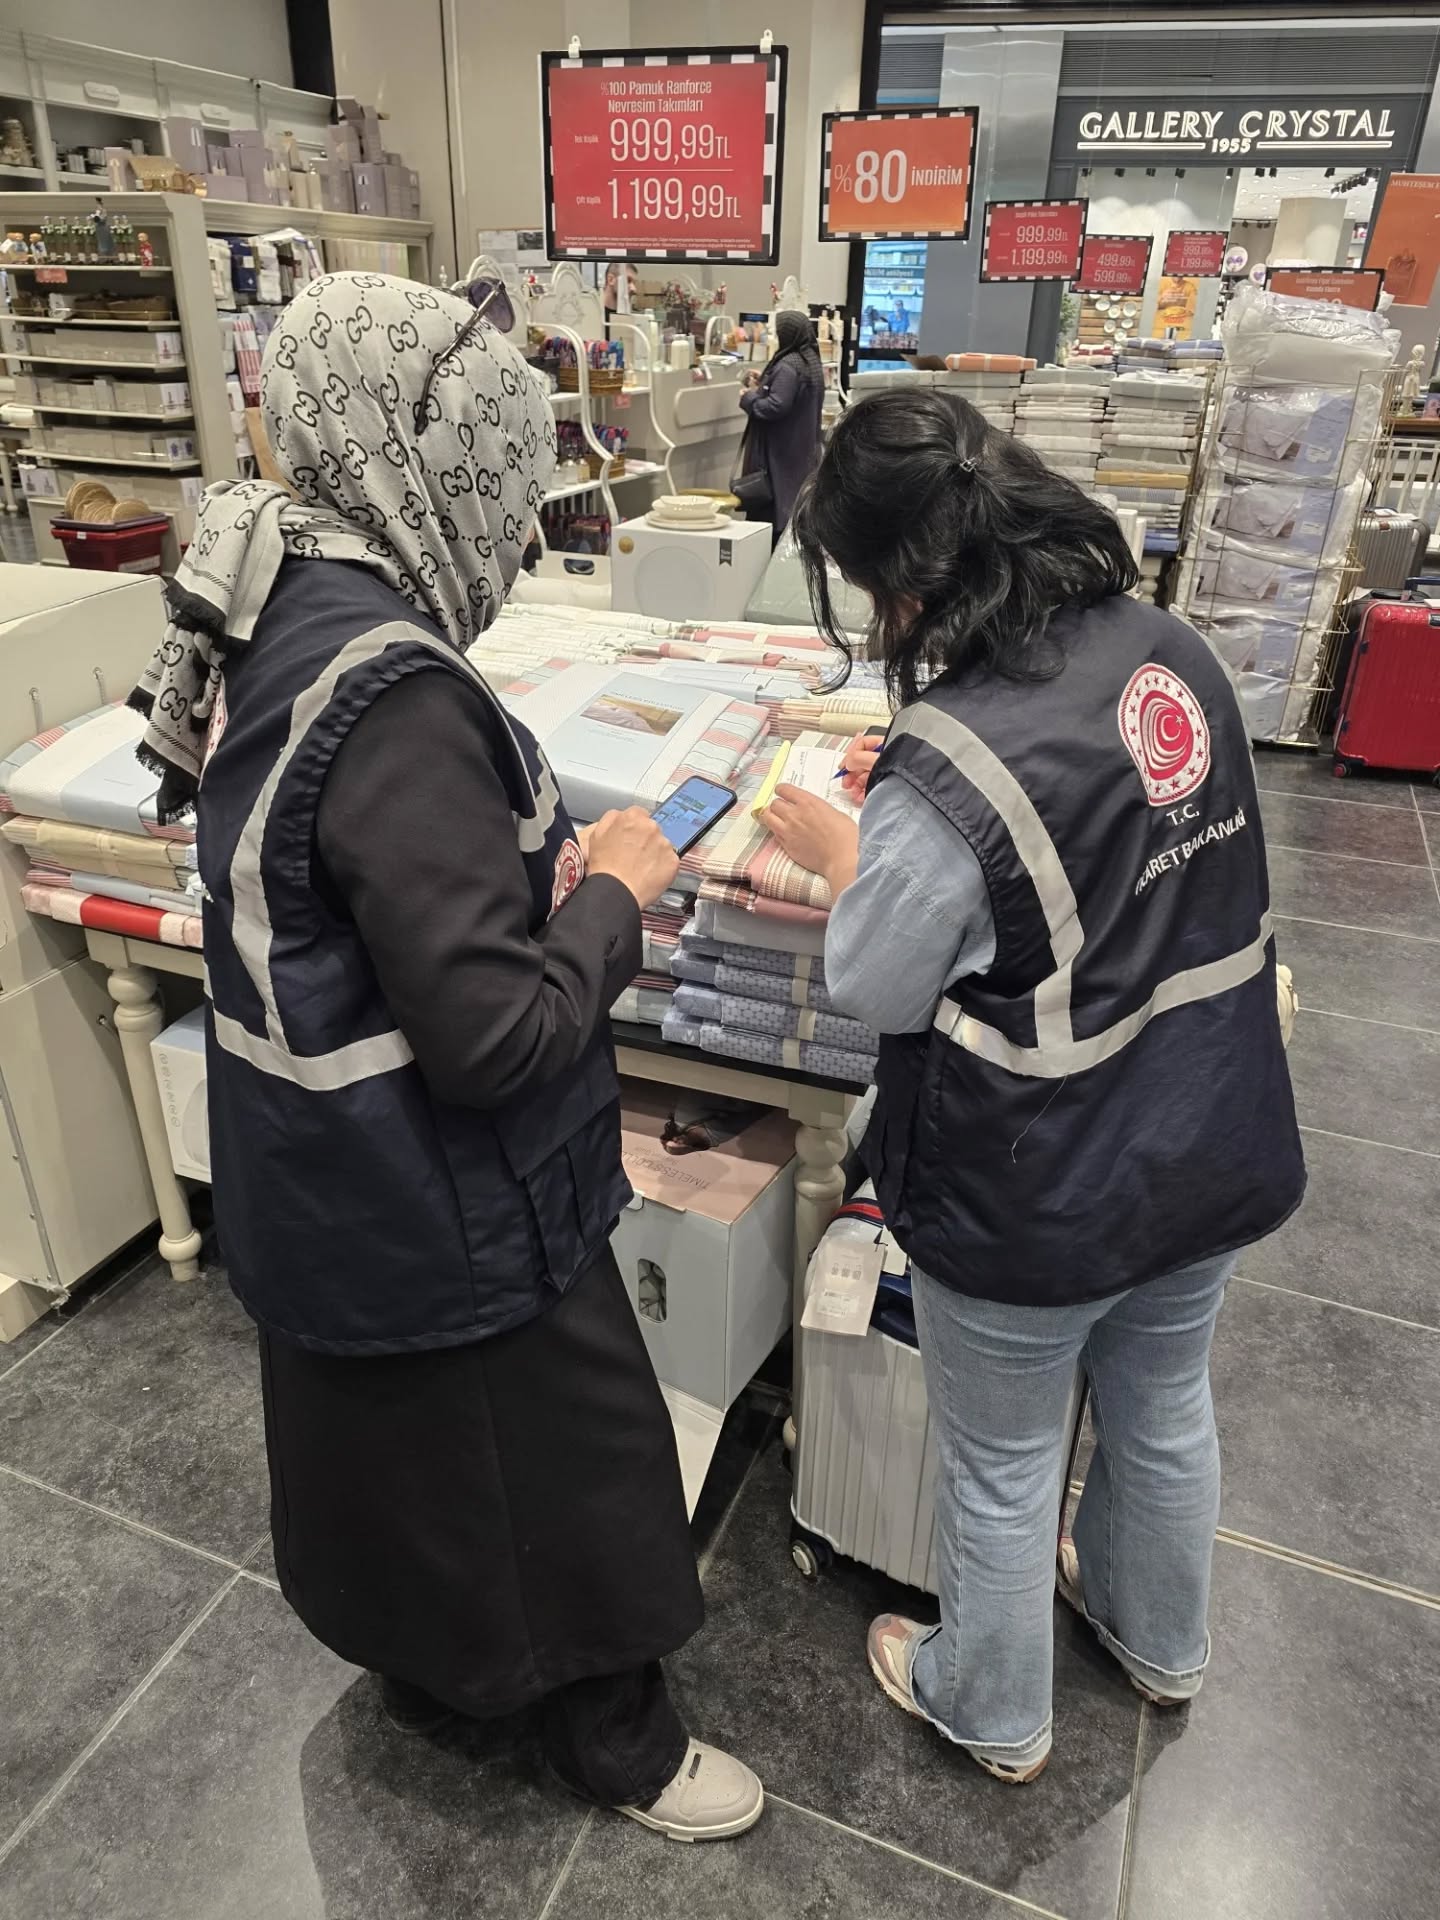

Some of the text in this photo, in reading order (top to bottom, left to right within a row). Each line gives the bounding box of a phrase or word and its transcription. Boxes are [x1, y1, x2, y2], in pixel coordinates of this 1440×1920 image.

[600, 79, 712, 96] %100 Pamuk Ranforce
[608, 97, 703, 113] Nevresim Takımları
[1079, 109, 1395, 139] GALLERY CRYSTAL
[1211, 138, 1252, 154] 1955
[911, 165, 963, 186] İNDİRİM
[1166, 803, 1200, 826] T.C.
